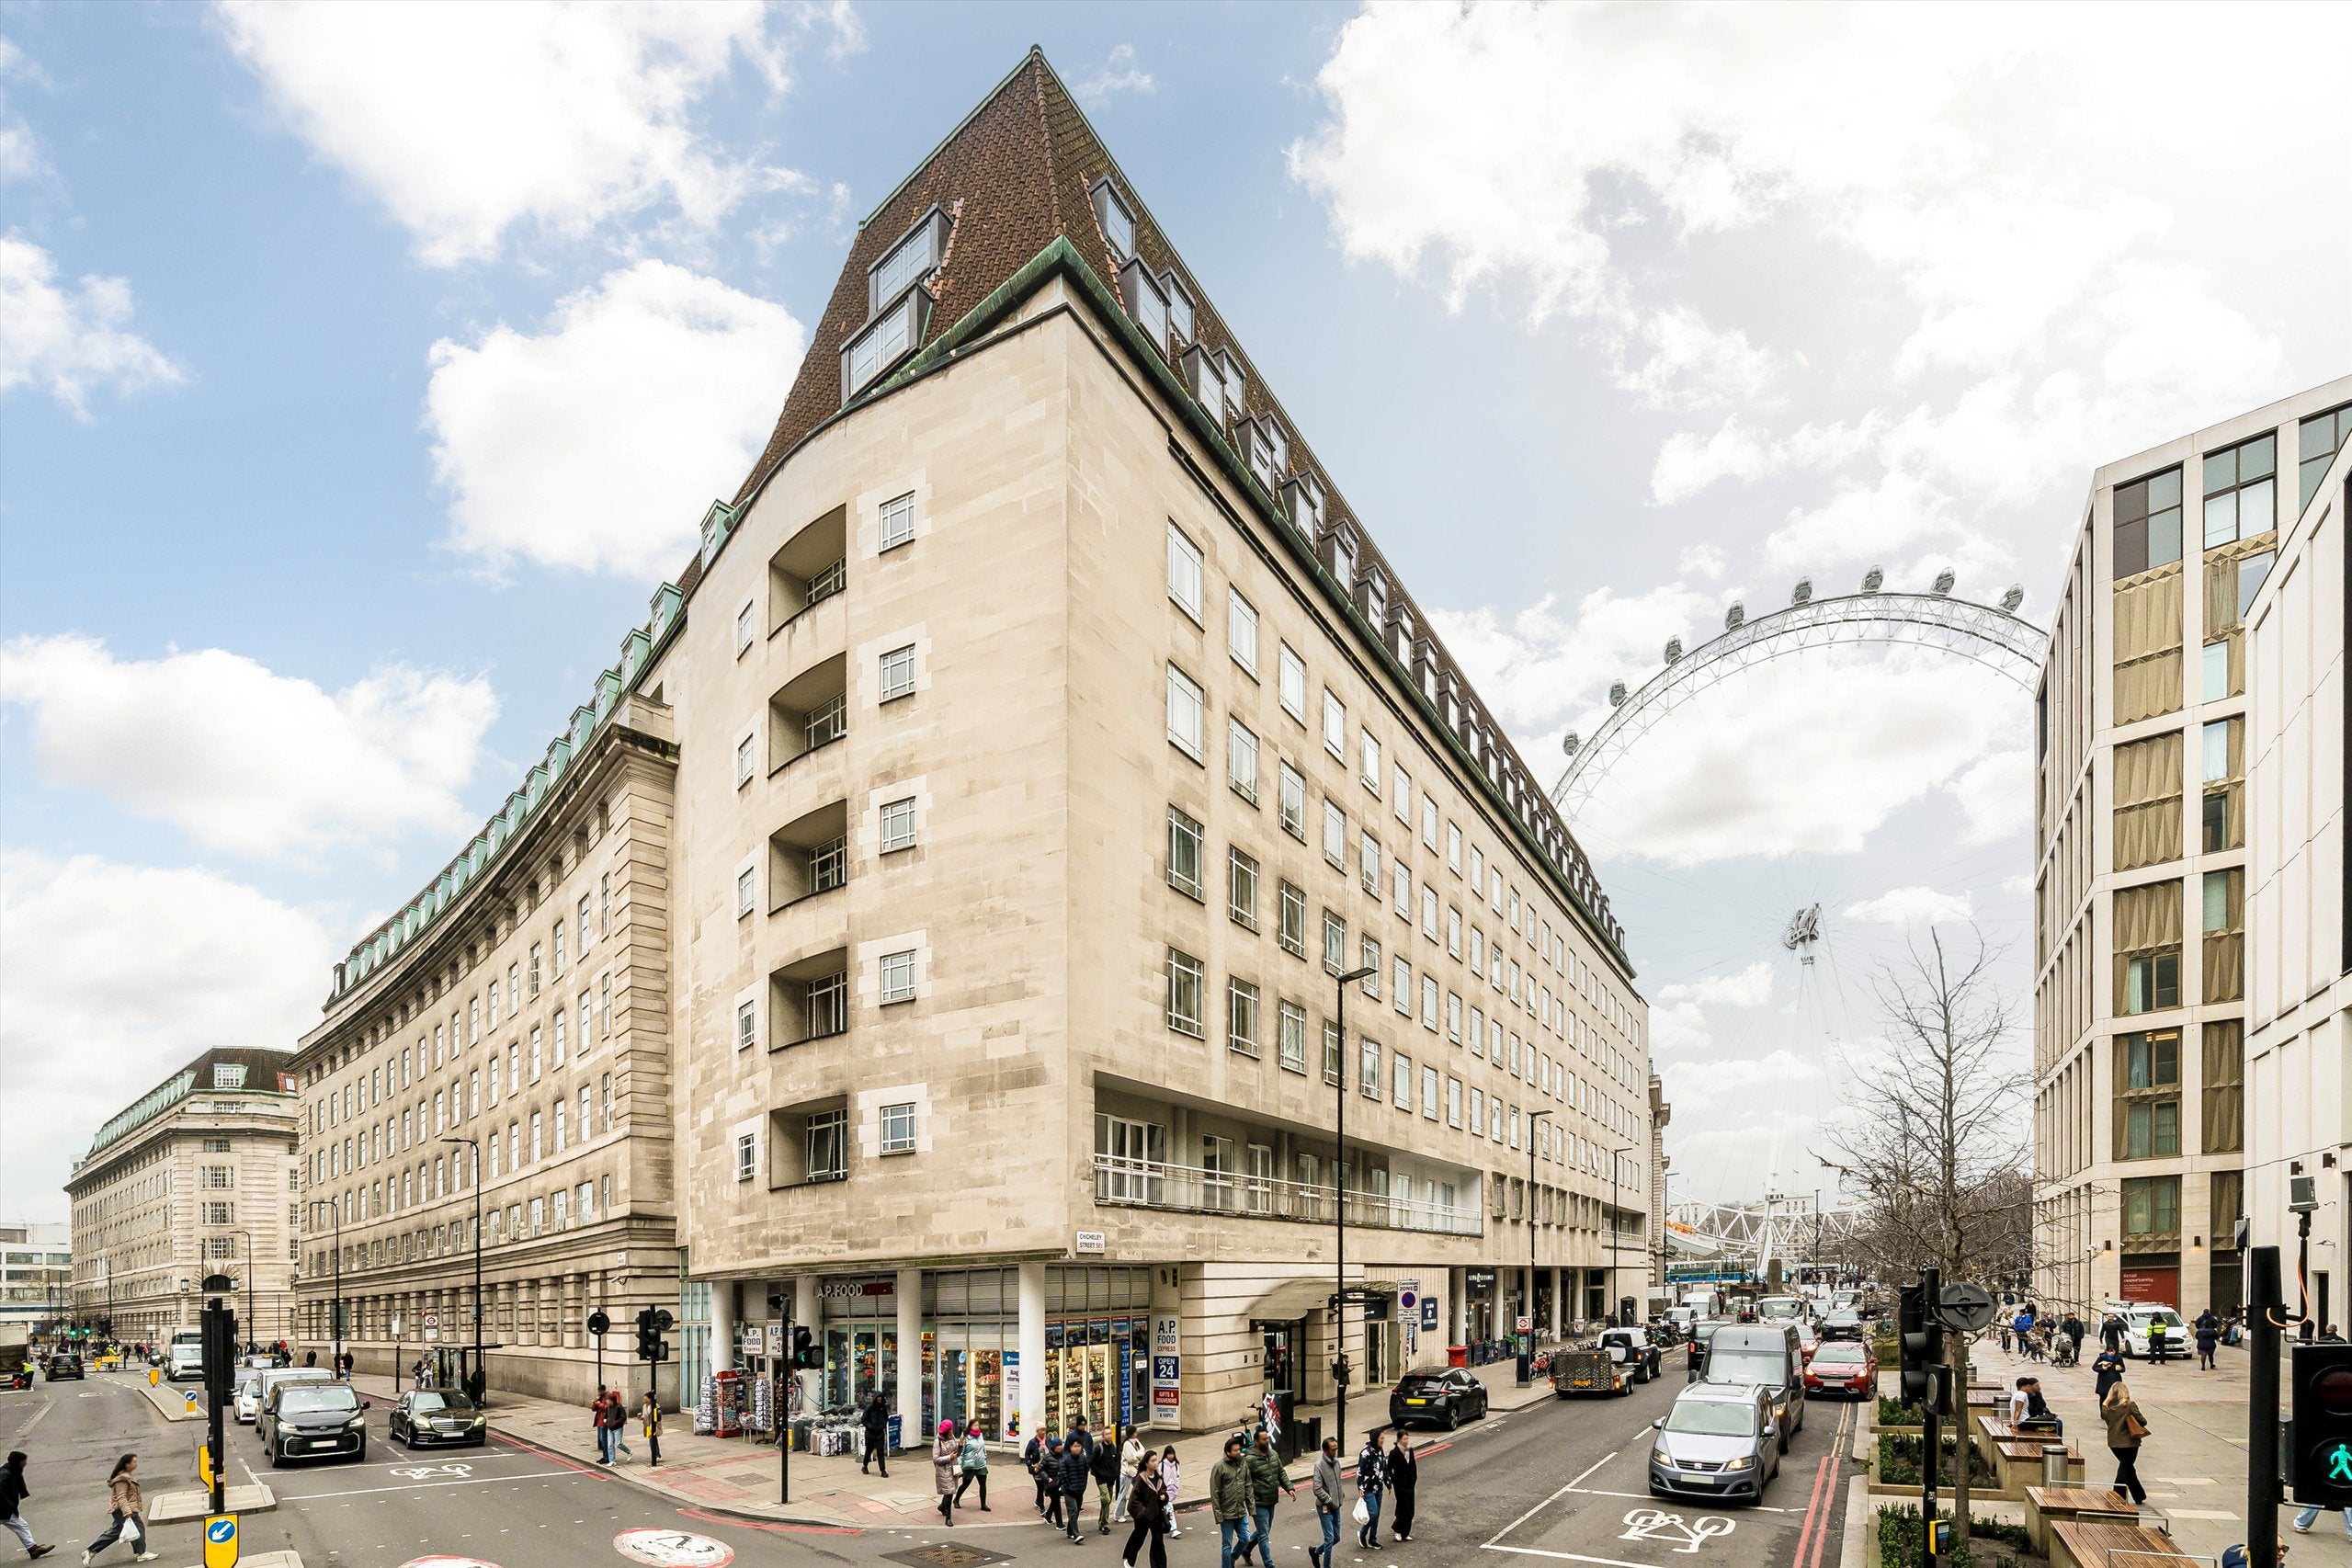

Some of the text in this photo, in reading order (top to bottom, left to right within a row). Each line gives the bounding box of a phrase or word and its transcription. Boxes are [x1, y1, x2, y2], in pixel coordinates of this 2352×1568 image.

[1158, 1320, 1176, 1334] A.P.
[1157, 1335, 1176, 1344] FOOD
[1159, 1365, 1174, 1378] 24
